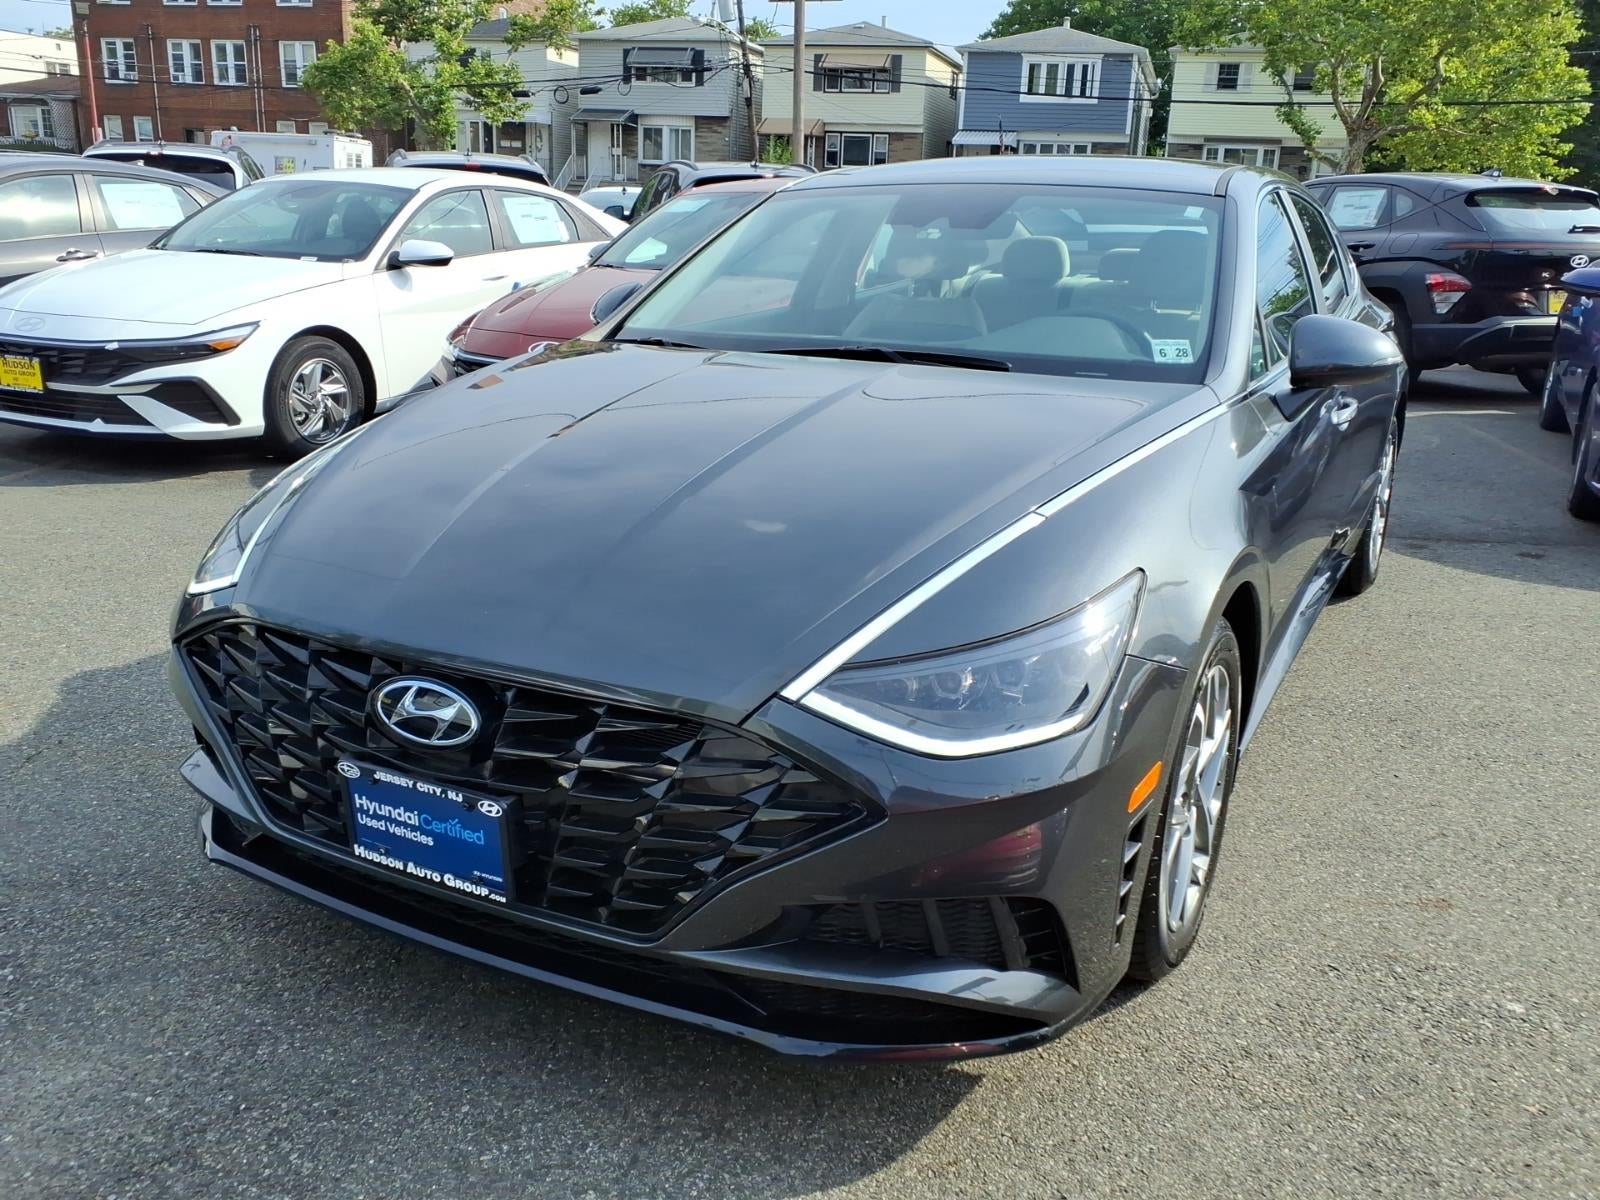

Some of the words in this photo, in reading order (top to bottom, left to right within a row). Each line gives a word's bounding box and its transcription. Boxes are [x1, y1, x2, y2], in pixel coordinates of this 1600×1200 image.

[2, 360, 35, 371] HUDSON
[1159, 348, 1167, 358] 6
[1175, 348, 1189, 358] 28
[373, 771, 414, 788] JERSEY
[416, 782, 445, 798] CITY,
[448, 791, 463, 803] NJ
[354, 793, 419, 826] Hyundai
[420, 814, 485, 845] Certified
[357, 812, 386, 831] Used
[386, 821, 434, 846] Vehicles
